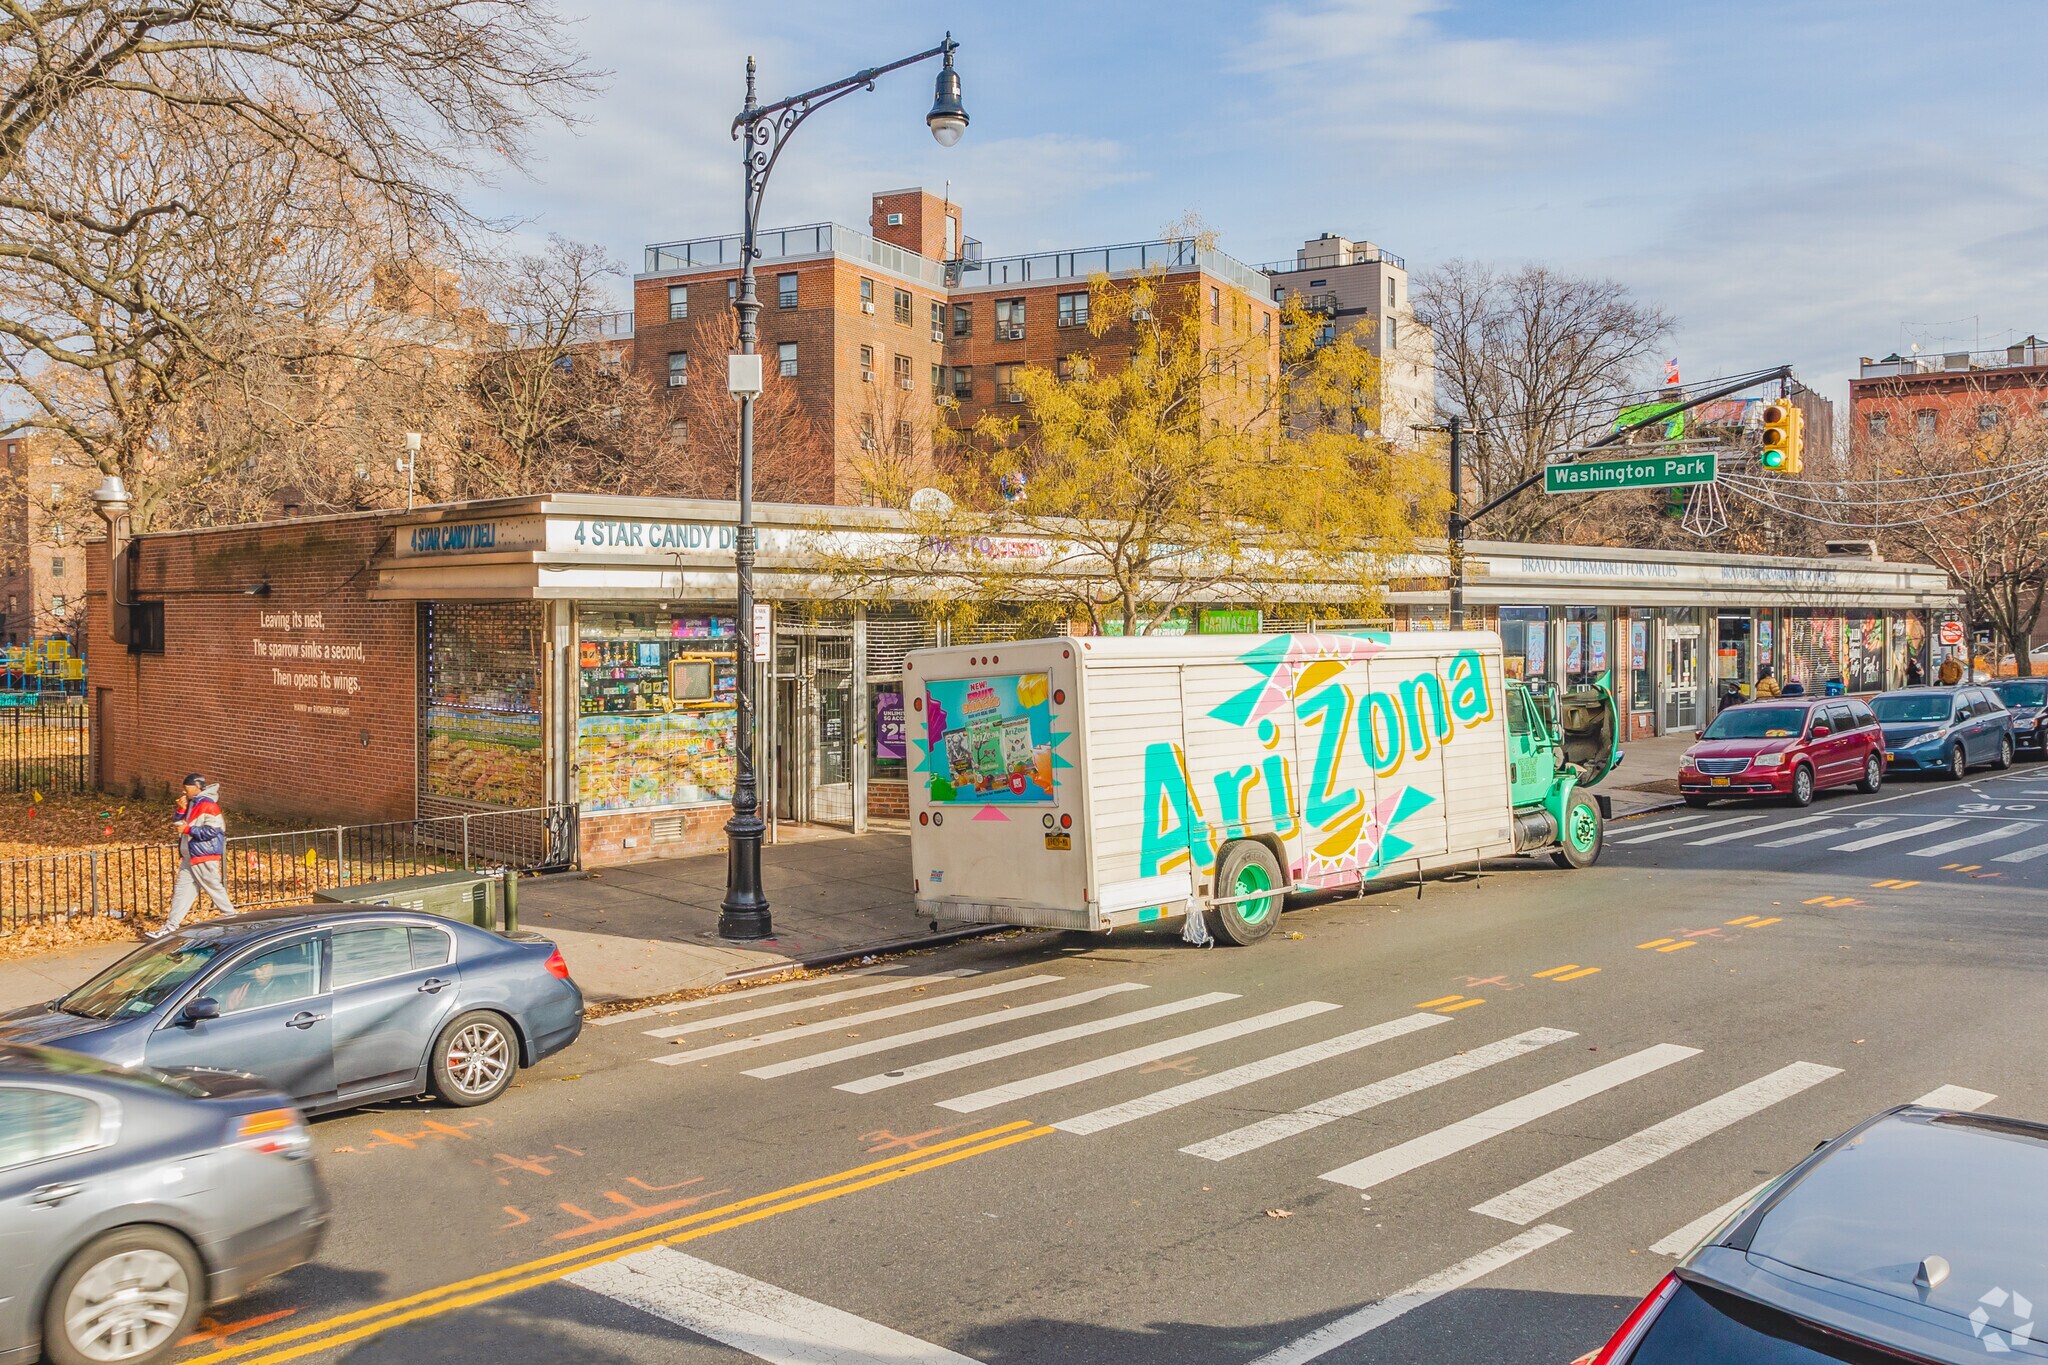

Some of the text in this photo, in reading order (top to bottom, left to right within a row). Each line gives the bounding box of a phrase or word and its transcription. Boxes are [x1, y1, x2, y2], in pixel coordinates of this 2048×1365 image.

[1555, 459, 1706, 484] Washington Park
[411, 523, 495, 552] 4 STAR CANDY DELI
[575, 521, 759, 550] 4 STAR CANDY DI
[1521, 558, 1678, 577] BRAVO SUPERMARKET FOR VALUES
[261, 610, 325, 632] Leaving its nest,
[1203, 615, 1254, 633] FARMACIA
[253, 639, 366, 663] The sparrow sinks a second,
[272, 668, 292, 686] Then
[293, 673, 318, 691] opens
[320, 670, 331, 689] its
[1139, 649, 1493, 923] AriZona
